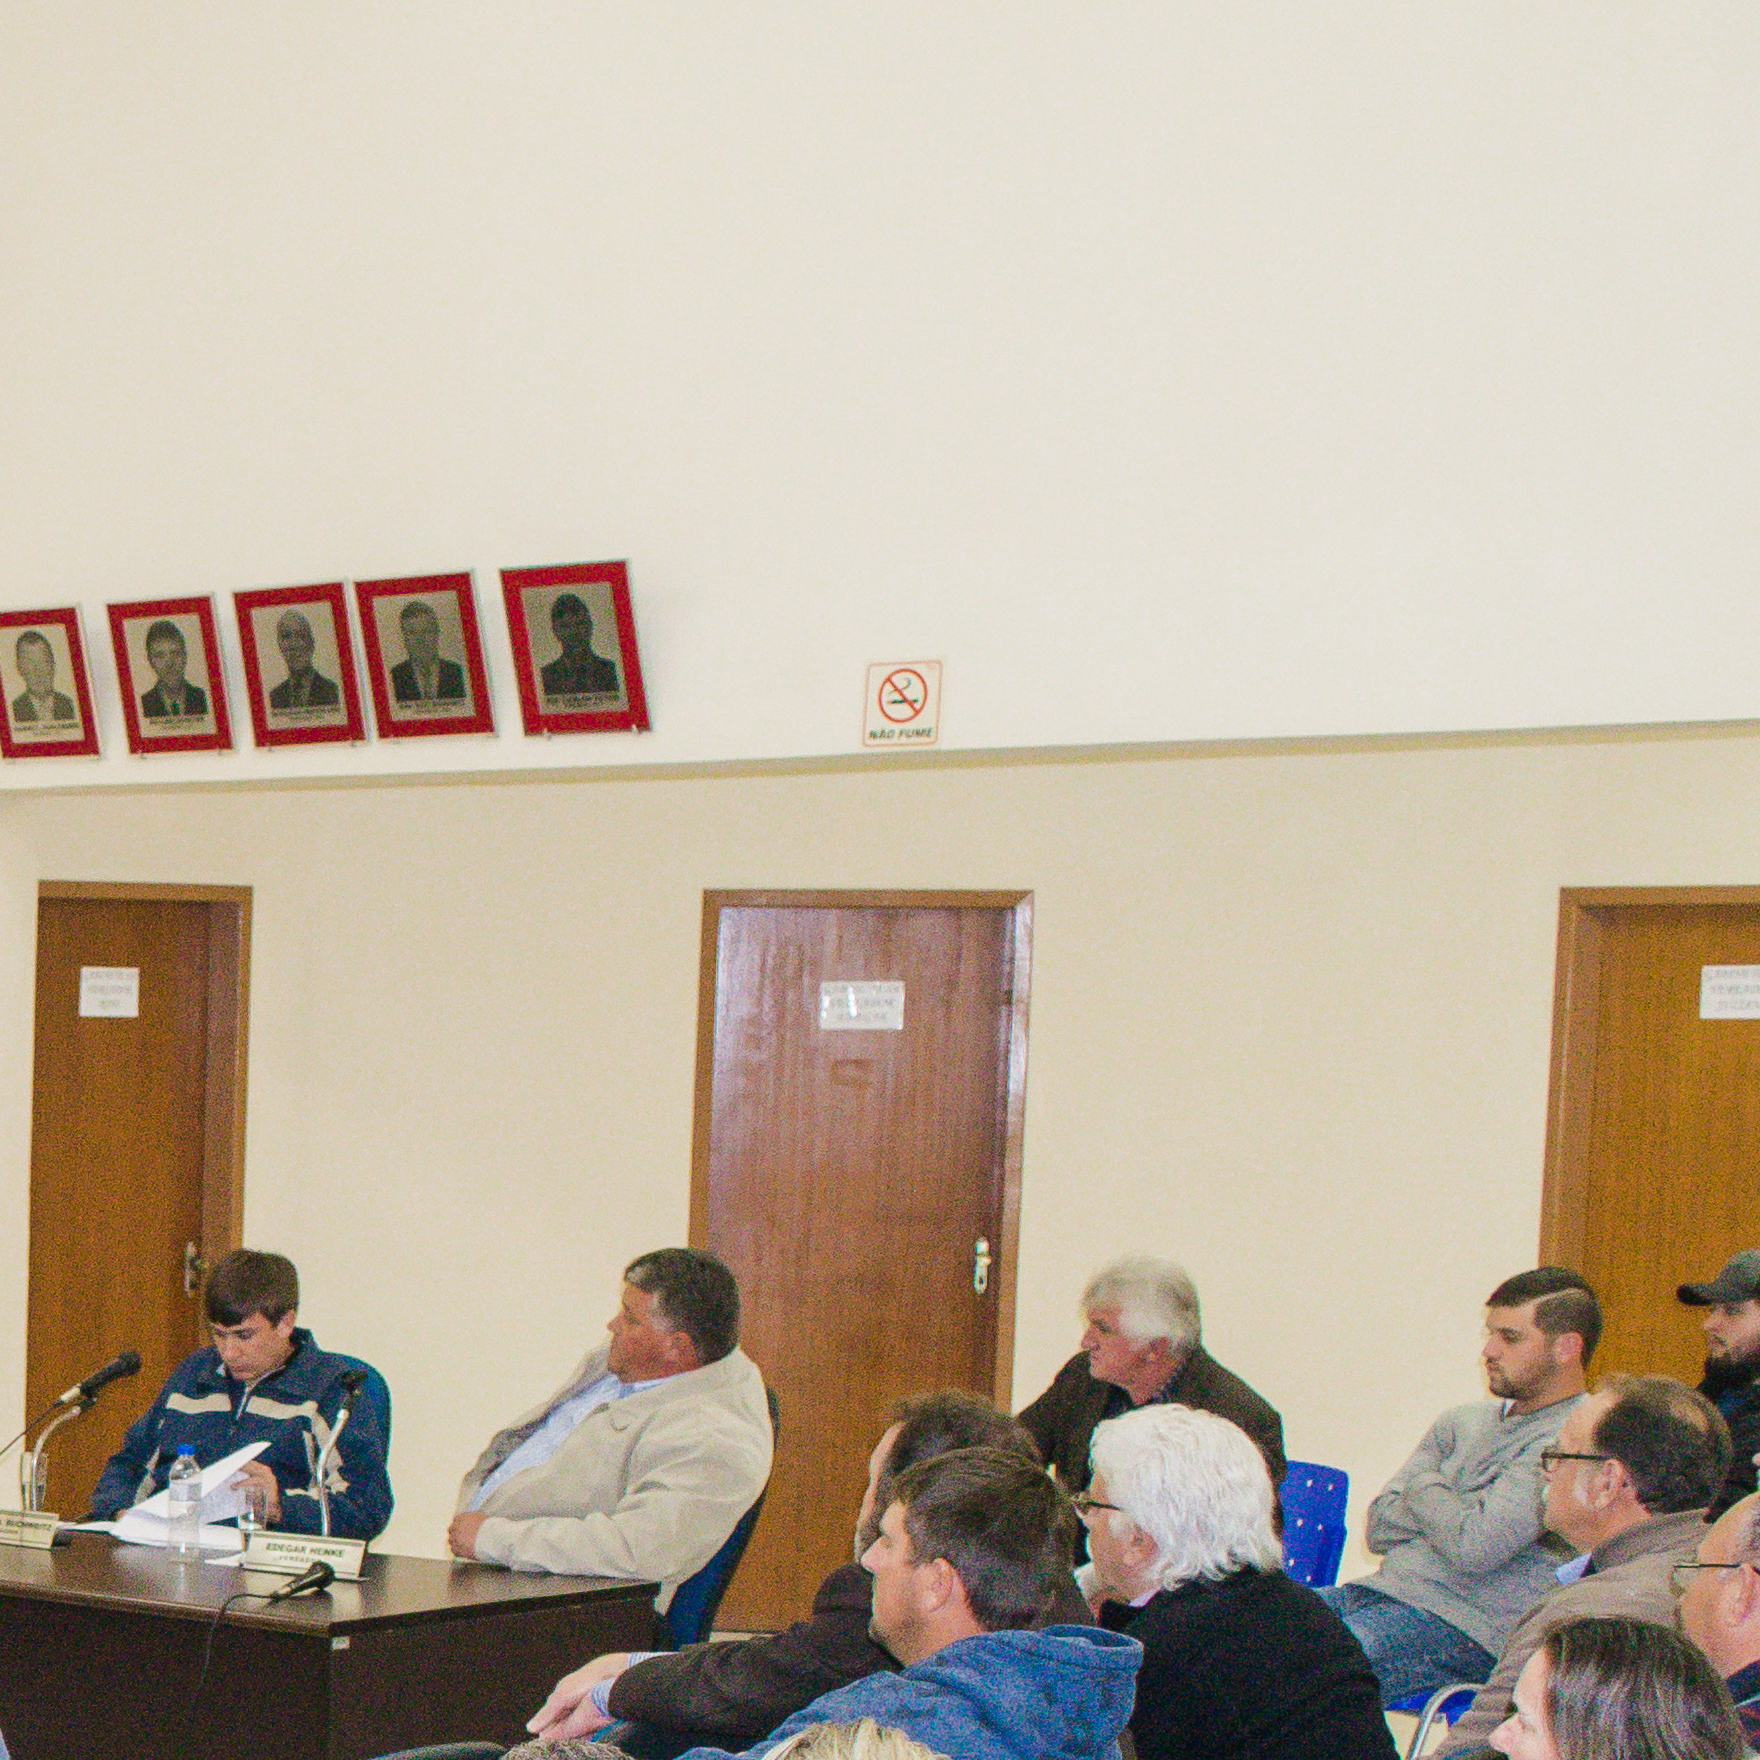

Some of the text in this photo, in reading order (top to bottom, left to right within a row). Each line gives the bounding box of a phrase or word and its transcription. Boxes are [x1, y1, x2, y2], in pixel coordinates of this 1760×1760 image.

[868, 726, 934, 740] NÃO FUME
[266, 1542, 346, 1558] EDEGAR HENKE
